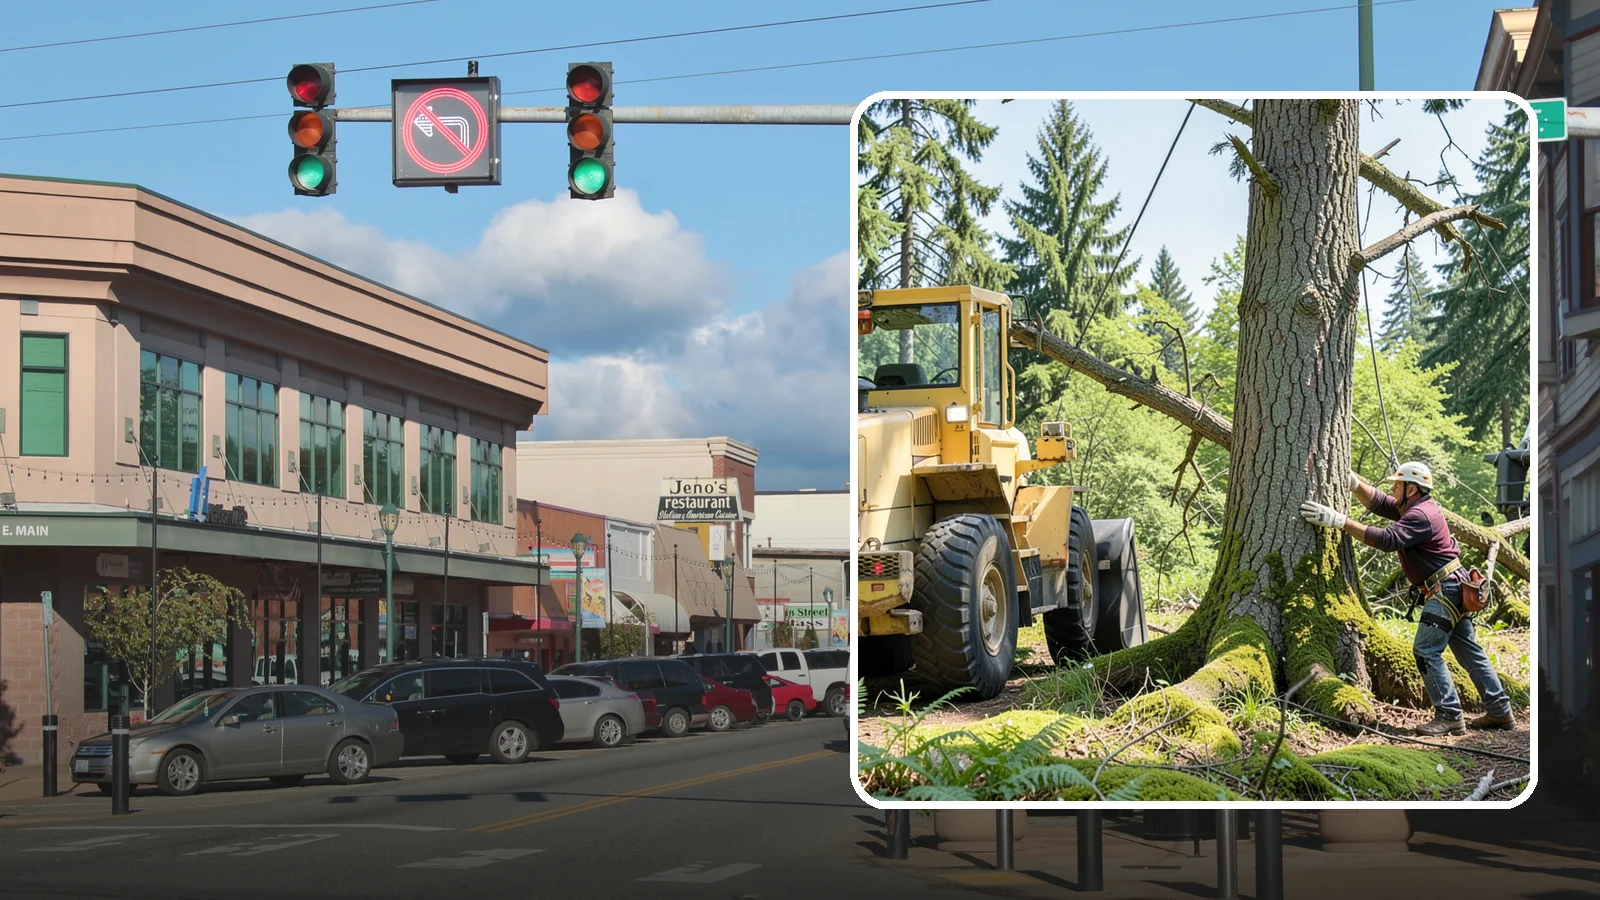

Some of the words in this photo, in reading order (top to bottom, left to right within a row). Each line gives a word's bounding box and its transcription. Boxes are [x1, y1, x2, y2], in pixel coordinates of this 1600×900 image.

[670, 480, 727, 494] Jeno's
[665, 496, 731, 509] restaurant
[715, 509, 737, 519] Cuisine
[2, 525, 13, 536] E.
[15, 525, 49, 536] MAIN
[797, 608, 828, 616] Street
